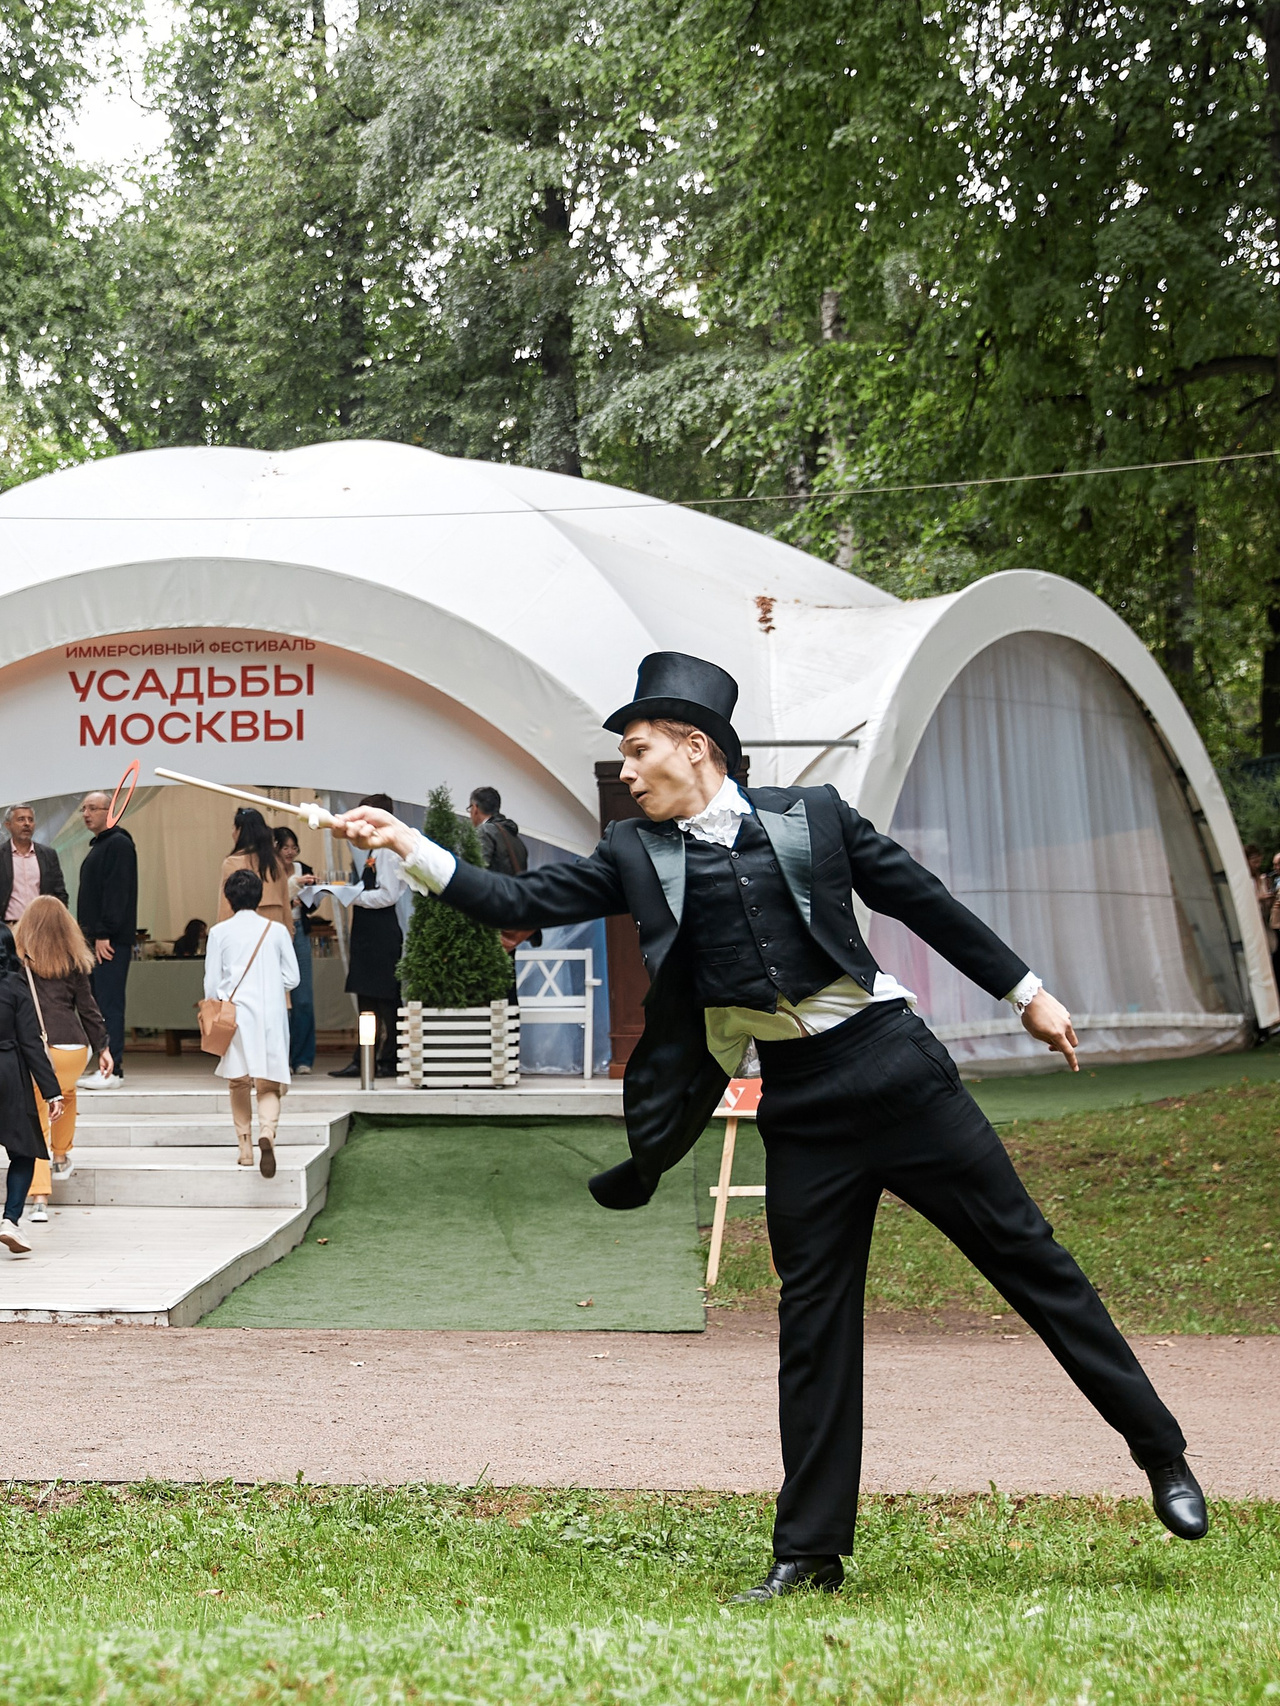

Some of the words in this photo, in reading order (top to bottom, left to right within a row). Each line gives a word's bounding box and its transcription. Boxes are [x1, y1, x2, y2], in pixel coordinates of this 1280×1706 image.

[66, 640, 205, 658] ИММЕРСИВНЫЙ
[209, 639, 316, 653] ФЕСТИВАЛЬ
[68, 664, 314, 706] УСАДЬБЫ
[80, 709, 304, 747] МОСКВЫ
